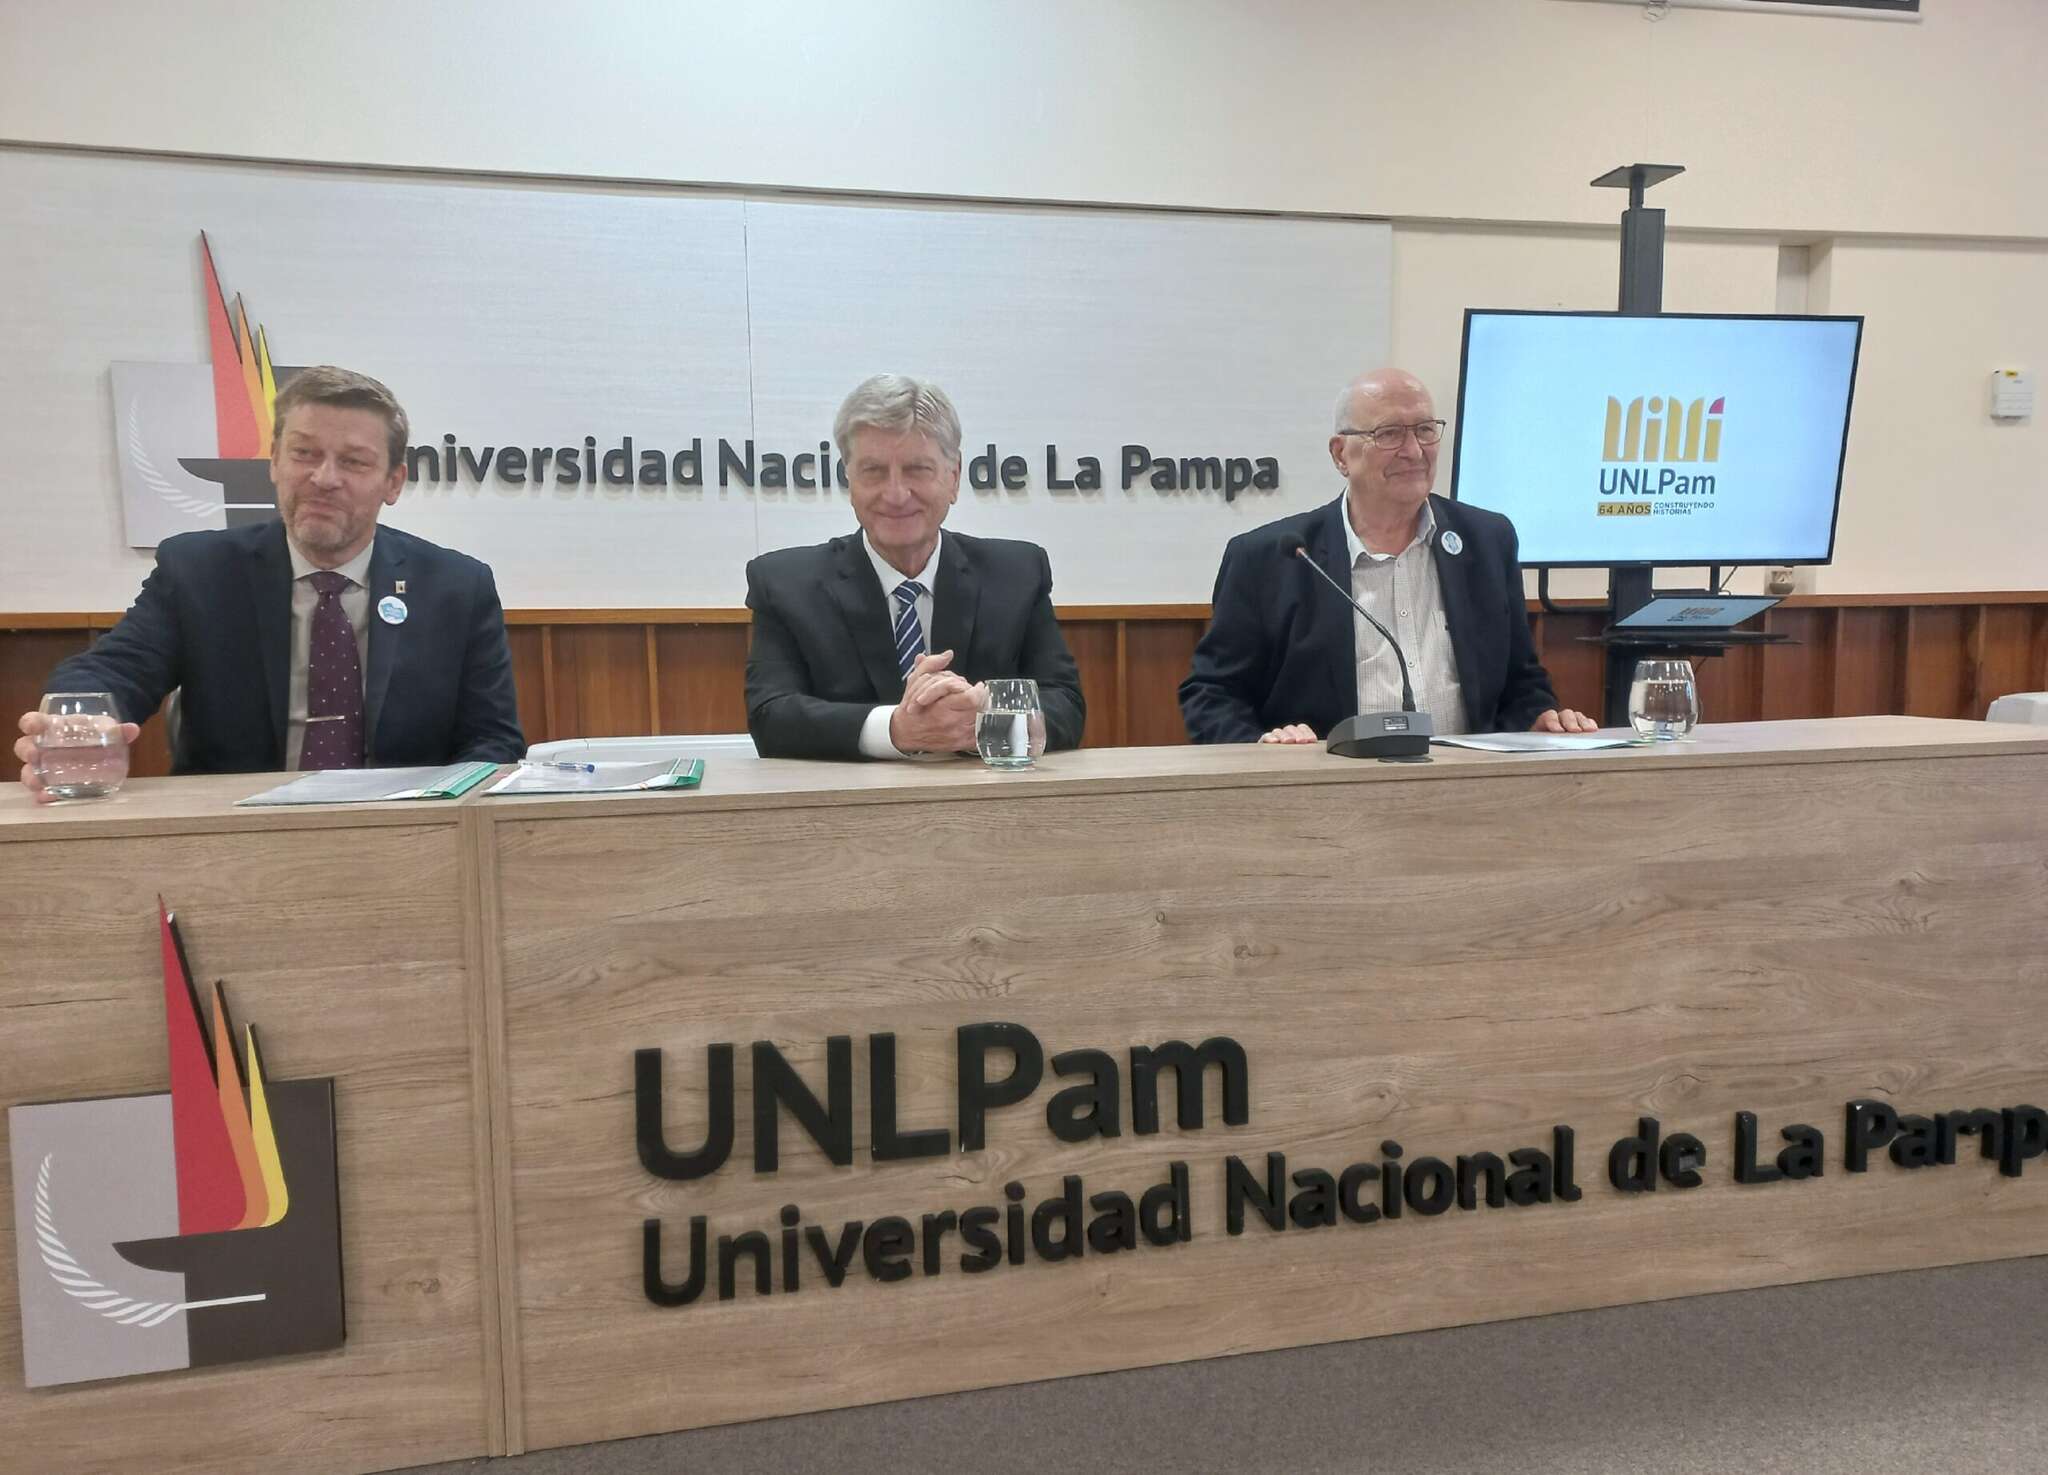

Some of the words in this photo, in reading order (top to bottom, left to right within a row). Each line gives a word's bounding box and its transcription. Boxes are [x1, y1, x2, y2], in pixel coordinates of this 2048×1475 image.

[406, 433, 703, 486] niversidad
[968, 444, 1028, 490] de
[1046, 445, 1101, 490] La
[1121, 445, 1279, 502] Pampa
[1599, 468, 1716, 495] UNLPam
[1599, 504, 1614, 515] 64
[1617, 502, 1651, 515] AÑOS
[635, 1022, 1249, 1180] UNLPam
[643, 1160, 1191, 1308] Universidad
[1225, 1125, 1582, 1236] Nacional
[1608, 1116, 1707, 1192] de
[1734, 1110, 1824, 1184] La
[1844, 1098, 2048, 1178] Pamp
